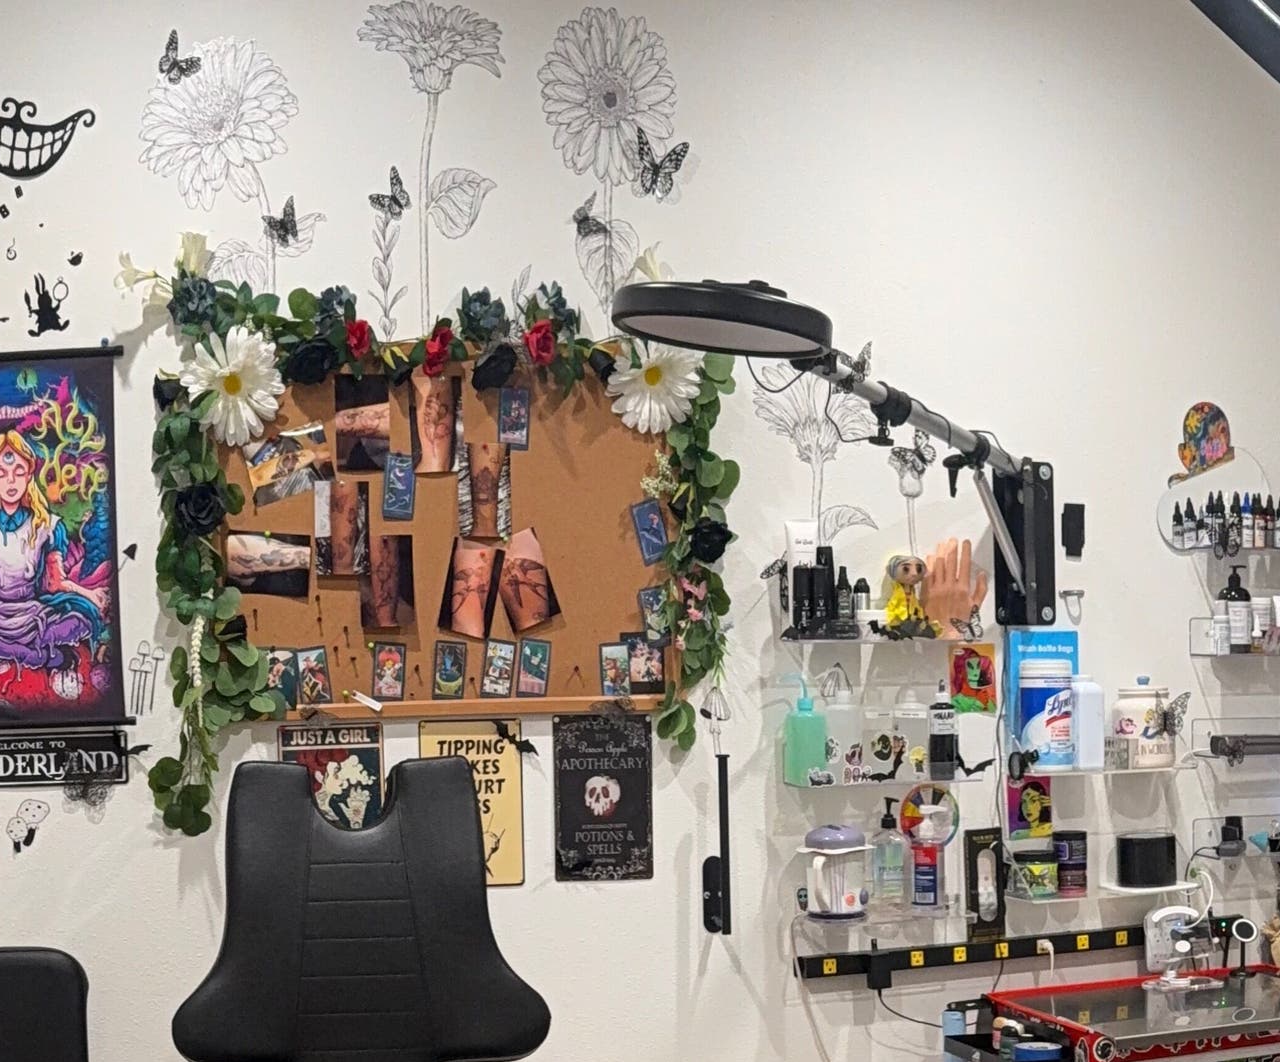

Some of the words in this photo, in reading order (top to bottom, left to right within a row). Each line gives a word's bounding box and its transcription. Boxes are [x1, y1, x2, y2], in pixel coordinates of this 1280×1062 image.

[49, 740, 66, 749] TO
[290, 730, 322, 745] JUST
[322, 729, 334, 744] A
[338, 729, 371, 743] GIRL
[437, 738, 506, 756] TIPPING
[470, 758, 501, 775] KES
[561, 757, 644, 771] APOTHECARY
[475, 778, 506, 795] URT
[575, 830, 623, 843] POTIONS
[626, 830, 635, 841] &
[586, 843, 622, 855] SPELLS
